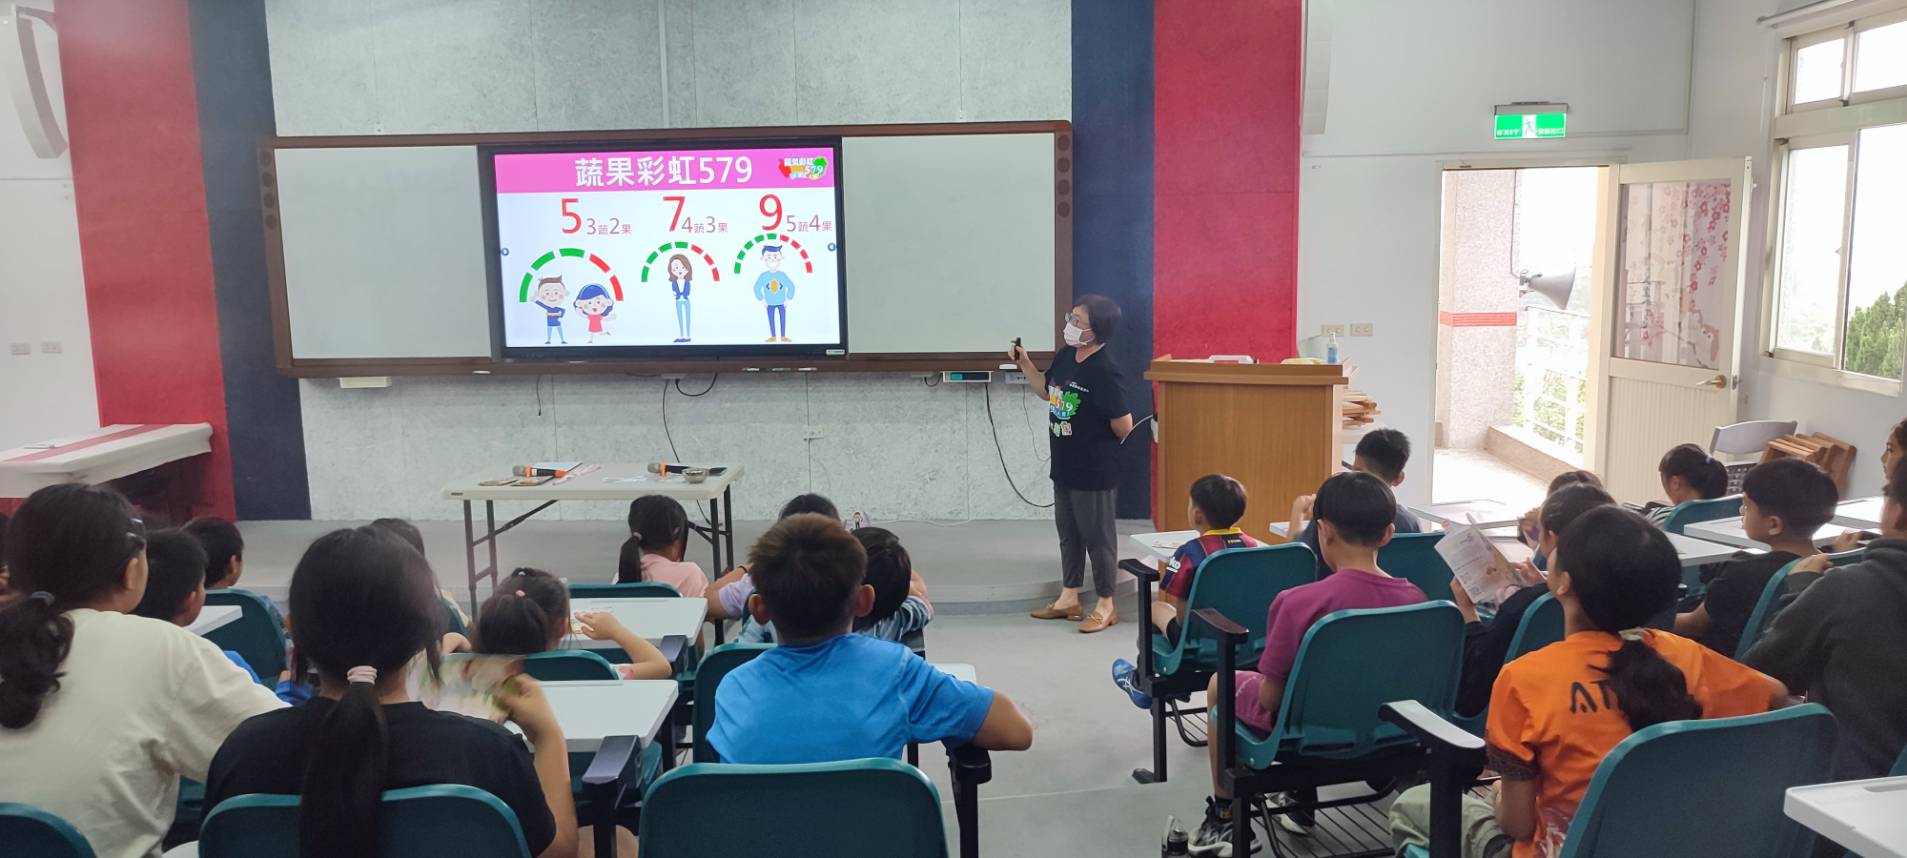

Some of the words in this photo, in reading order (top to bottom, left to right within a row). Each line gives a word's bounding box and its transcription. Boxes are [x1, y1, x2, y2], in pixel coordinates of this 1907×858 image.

[575, 156, 752, 187] 蔬果彩虹579
[561, 198, 582, 234] 5
[663, 196, 686, 232] 7
[759, 193, 783, 231] 9
